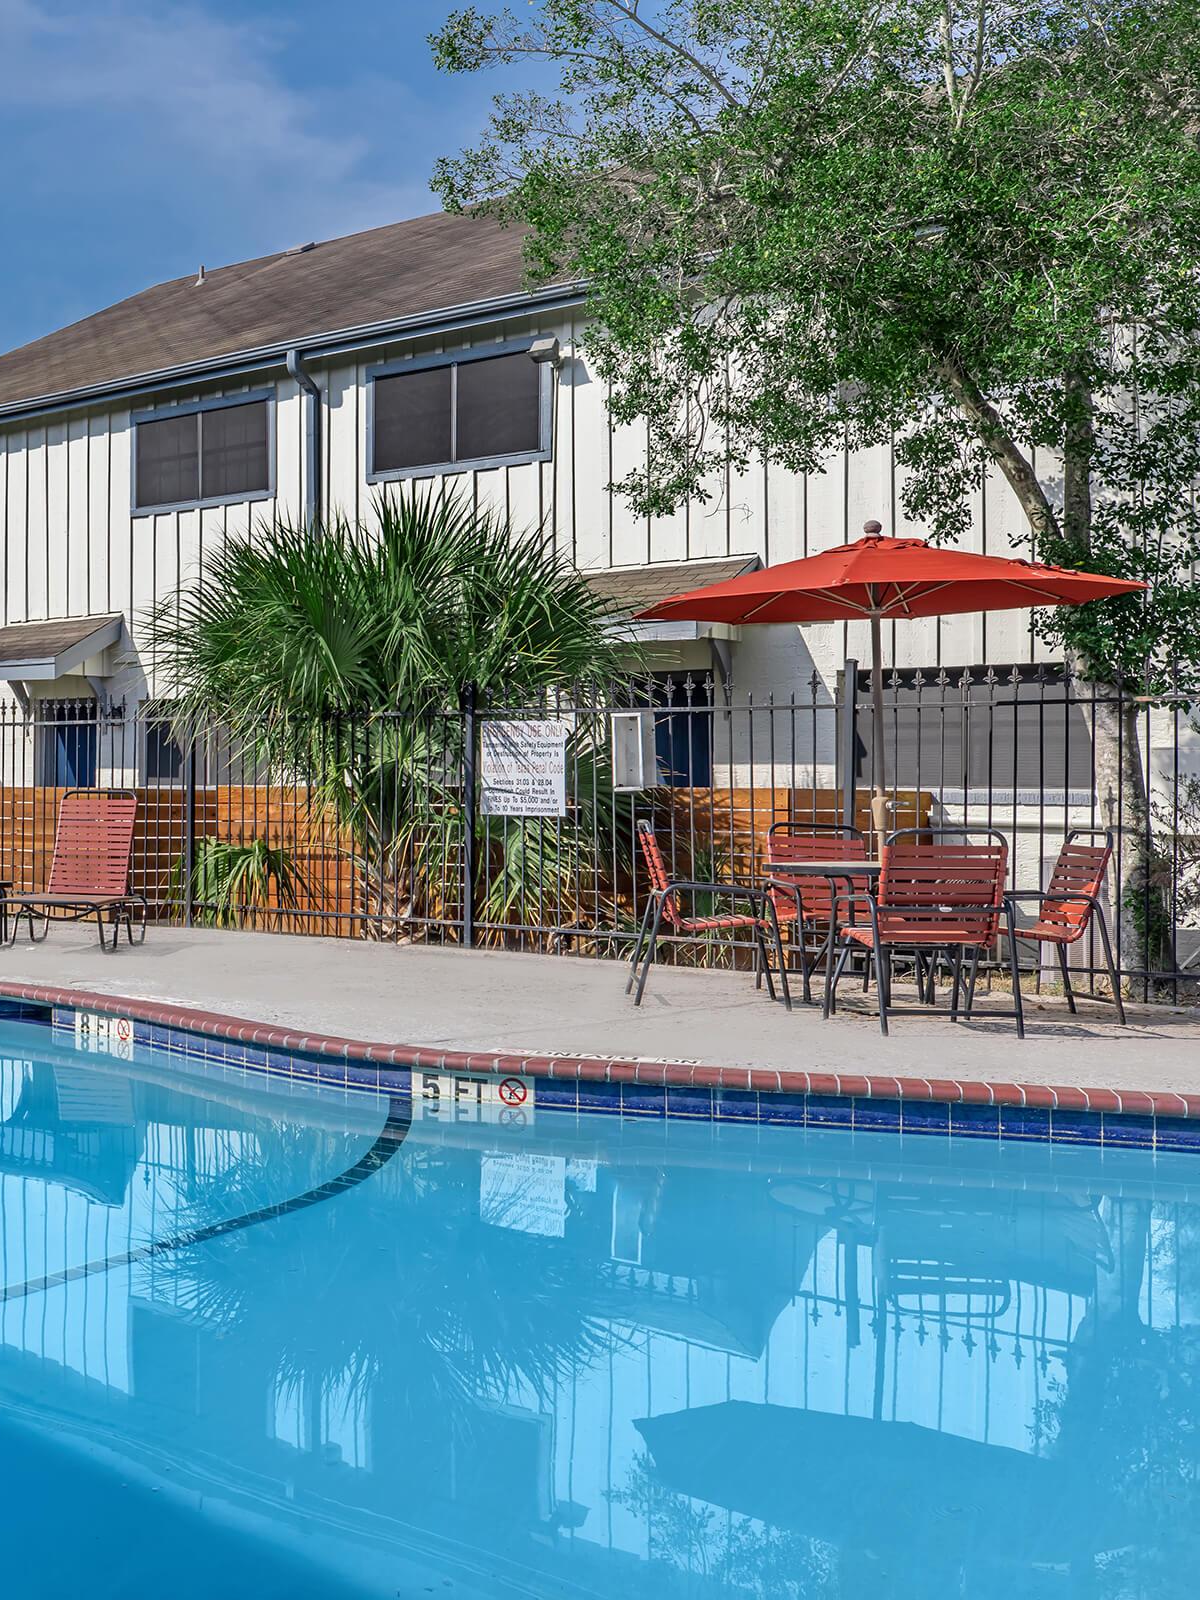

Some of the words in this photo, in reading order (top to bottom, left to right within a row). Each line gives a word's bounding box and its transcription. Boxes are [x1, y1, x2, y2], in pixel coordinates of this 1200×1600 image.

[528, 724, 542, 738] USE
[545, 724, 563, 738] ONLY
[520, 741, 537, 750] Safety
[537, 741, 564, 749] Equipment
[530, 750, 552, 759] Property
[549, 761, 564, 774] Code
[493, 778, 514, 786] Sections
[515, 787, 530, 795] Could
[504, 796, 510, 804] Up
[525, 805, 559, 814] Imprisonment
[81, 1013, 89, 1034] 8
[97, 1016, 113, 1037] FT
[422, 1073, 440, 1099] 5
[455, 1076, 488, 1104] FT
